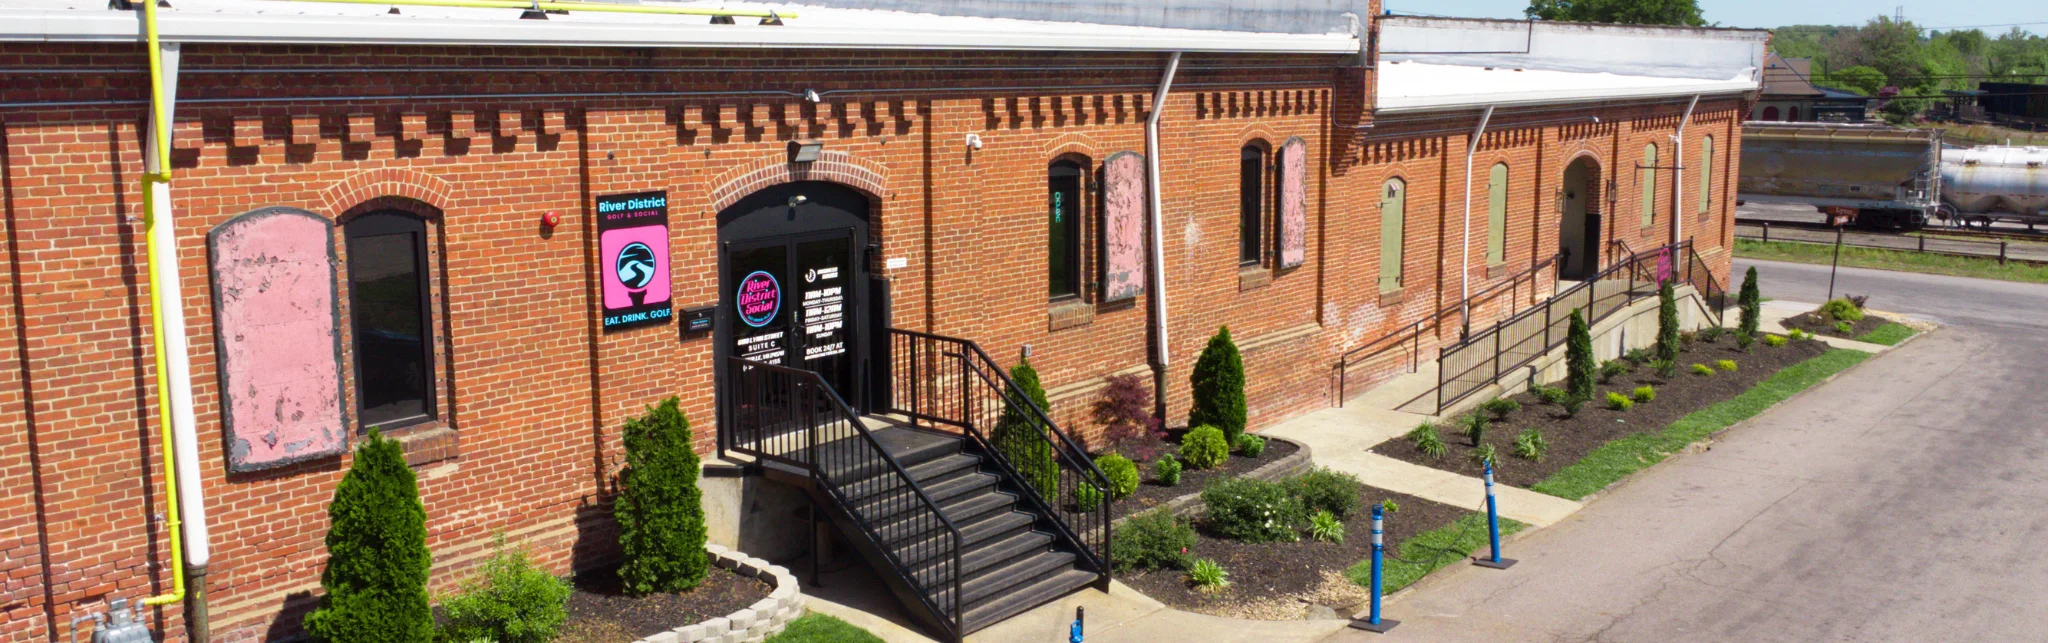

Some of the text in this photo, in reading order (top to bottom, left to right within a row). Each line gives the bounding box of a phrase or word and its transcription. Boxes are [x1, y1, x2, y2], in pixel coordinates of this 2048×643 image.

[599, 197, 666, 213] River District
[634, 210, 659, 218] SOCIAL
[746, 279, 770, 293] River
[741, 289, 776, 305] District
[745, 300, 773, 315] Social
[604, 308, 672, 326] EAT. DRINK. GOLF.
[748, 342, 769, 352] SUITE
[806, 346, 822, 355] BOOK
[823, 343, 835, 352] 24/7
[836, 341, 843, 349] AT
